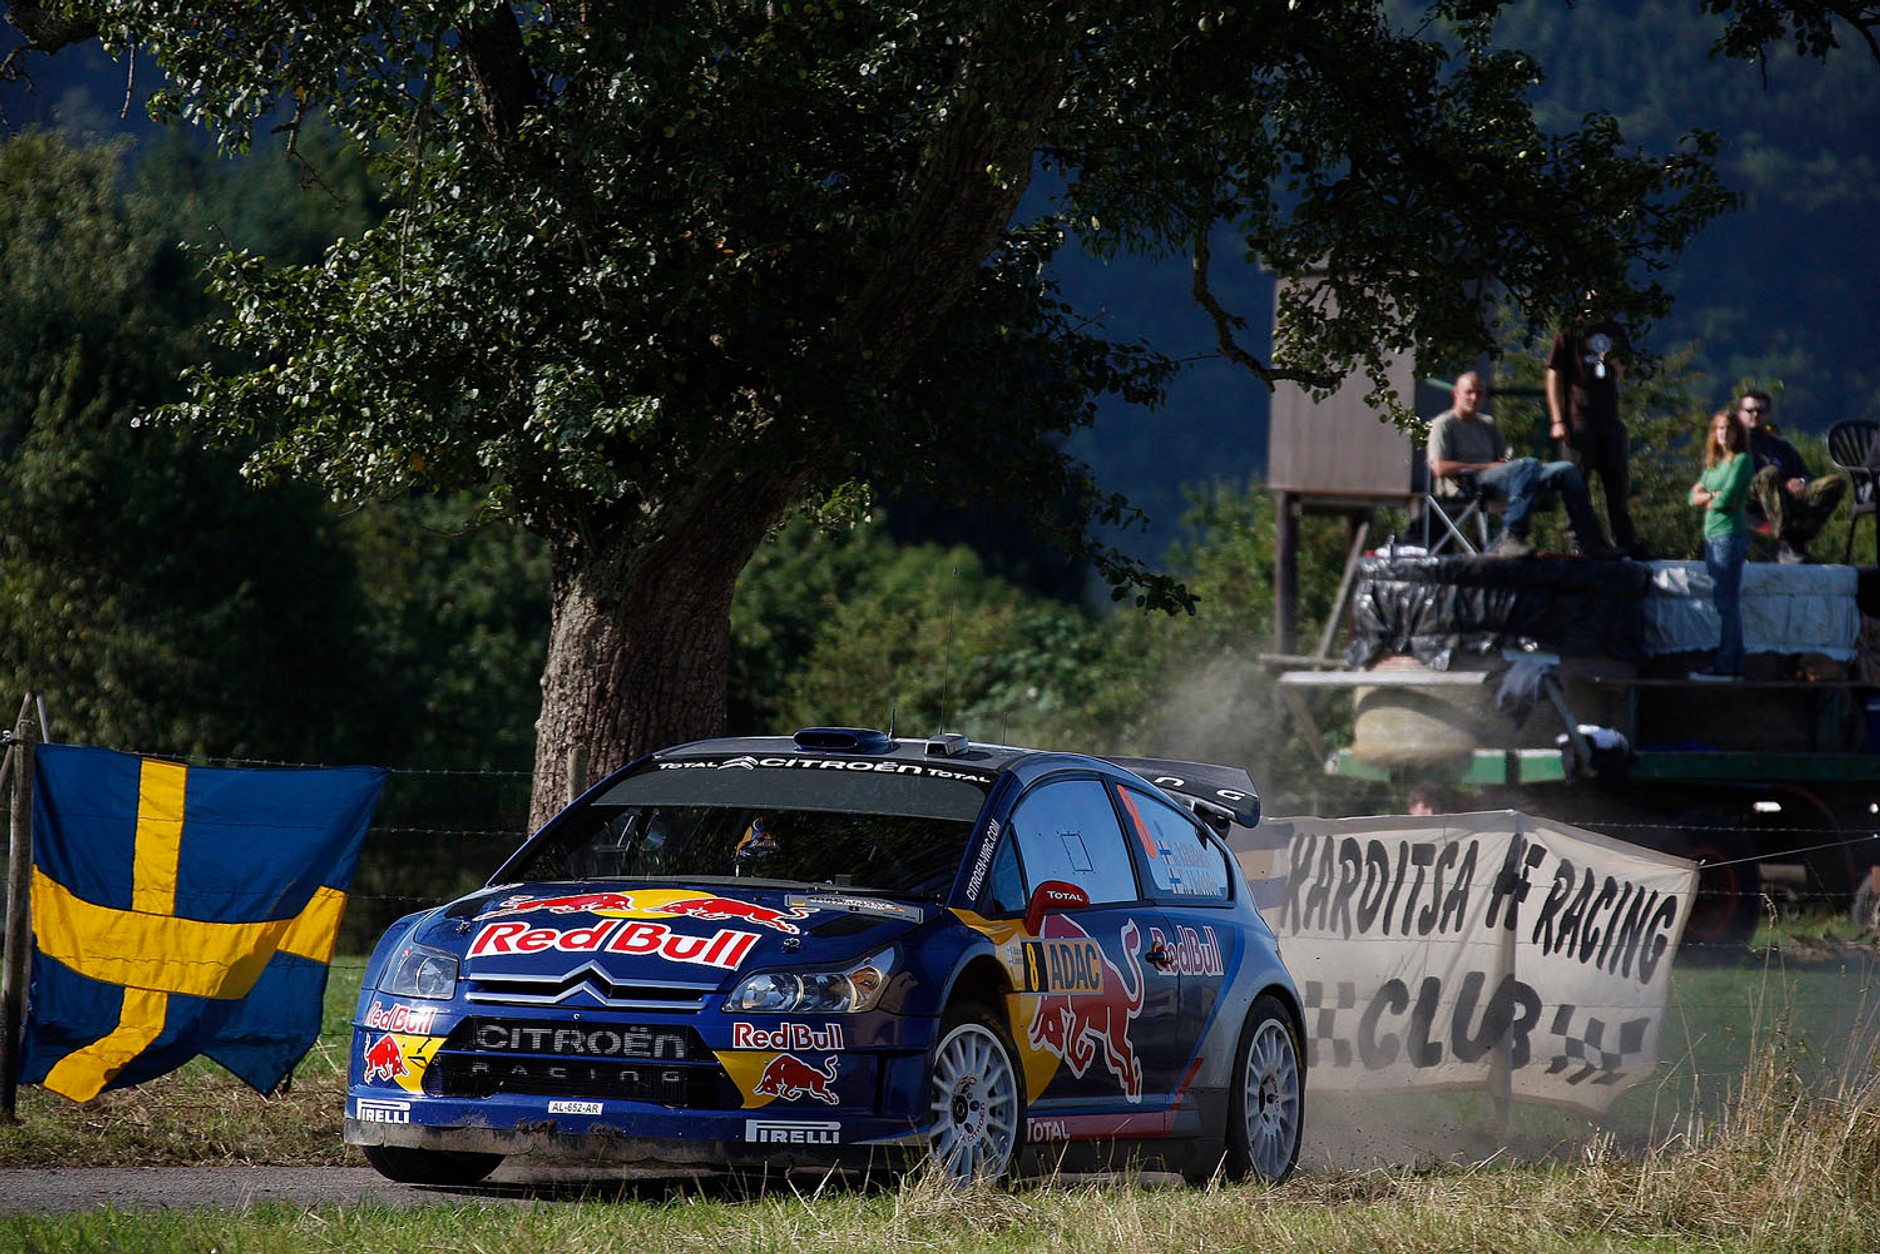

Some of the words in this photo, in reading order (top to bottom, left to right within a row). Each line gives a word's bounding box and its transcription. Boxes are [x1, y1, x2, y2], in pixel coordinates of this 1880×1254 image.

[658, 761, 718, 769] TOTAL
[927, 768, 991, 783] TOTAL
[1116, 784, 1157, 859] 8
[1046, 890, 1083, 902] TOTAL
[1280, 830, 1479, 941] KARDITSA
[1532, 858, 1678, 985] RACING
[1026, 942, 1040, 992] 8
[1049, 943, 1099, 990] ADAC
[1358, 971, 1543, 1070] CLUB
[357, 1098, 411, 1124] PIRELLI
[745, 1119, 841, 1144] PIRELLI
[1027, 1118, 1070, 1142] TOTAL
